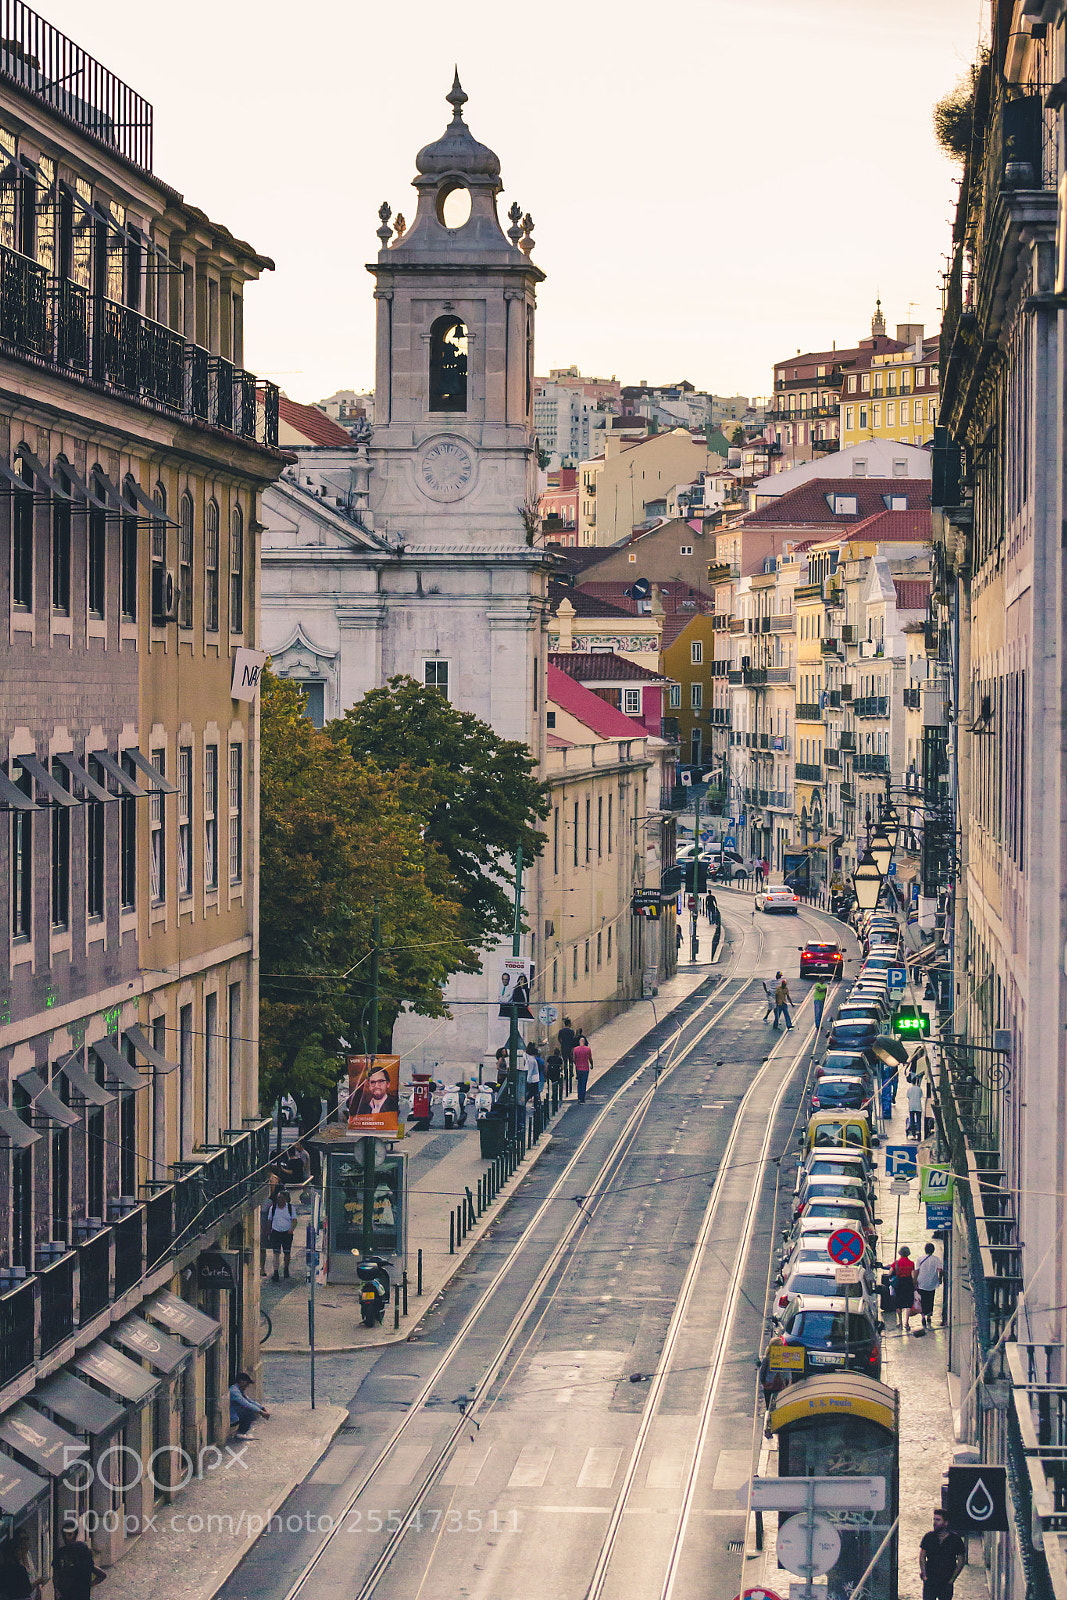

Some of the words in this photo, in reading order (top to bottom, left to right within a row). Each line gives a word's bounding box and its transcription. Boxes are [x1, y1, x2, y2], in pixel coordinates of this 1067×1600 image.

[891, 970, 903, 985] P
[892, 1150, 910, 1173] P
[829, 1398, 852, 1407] Paulo
